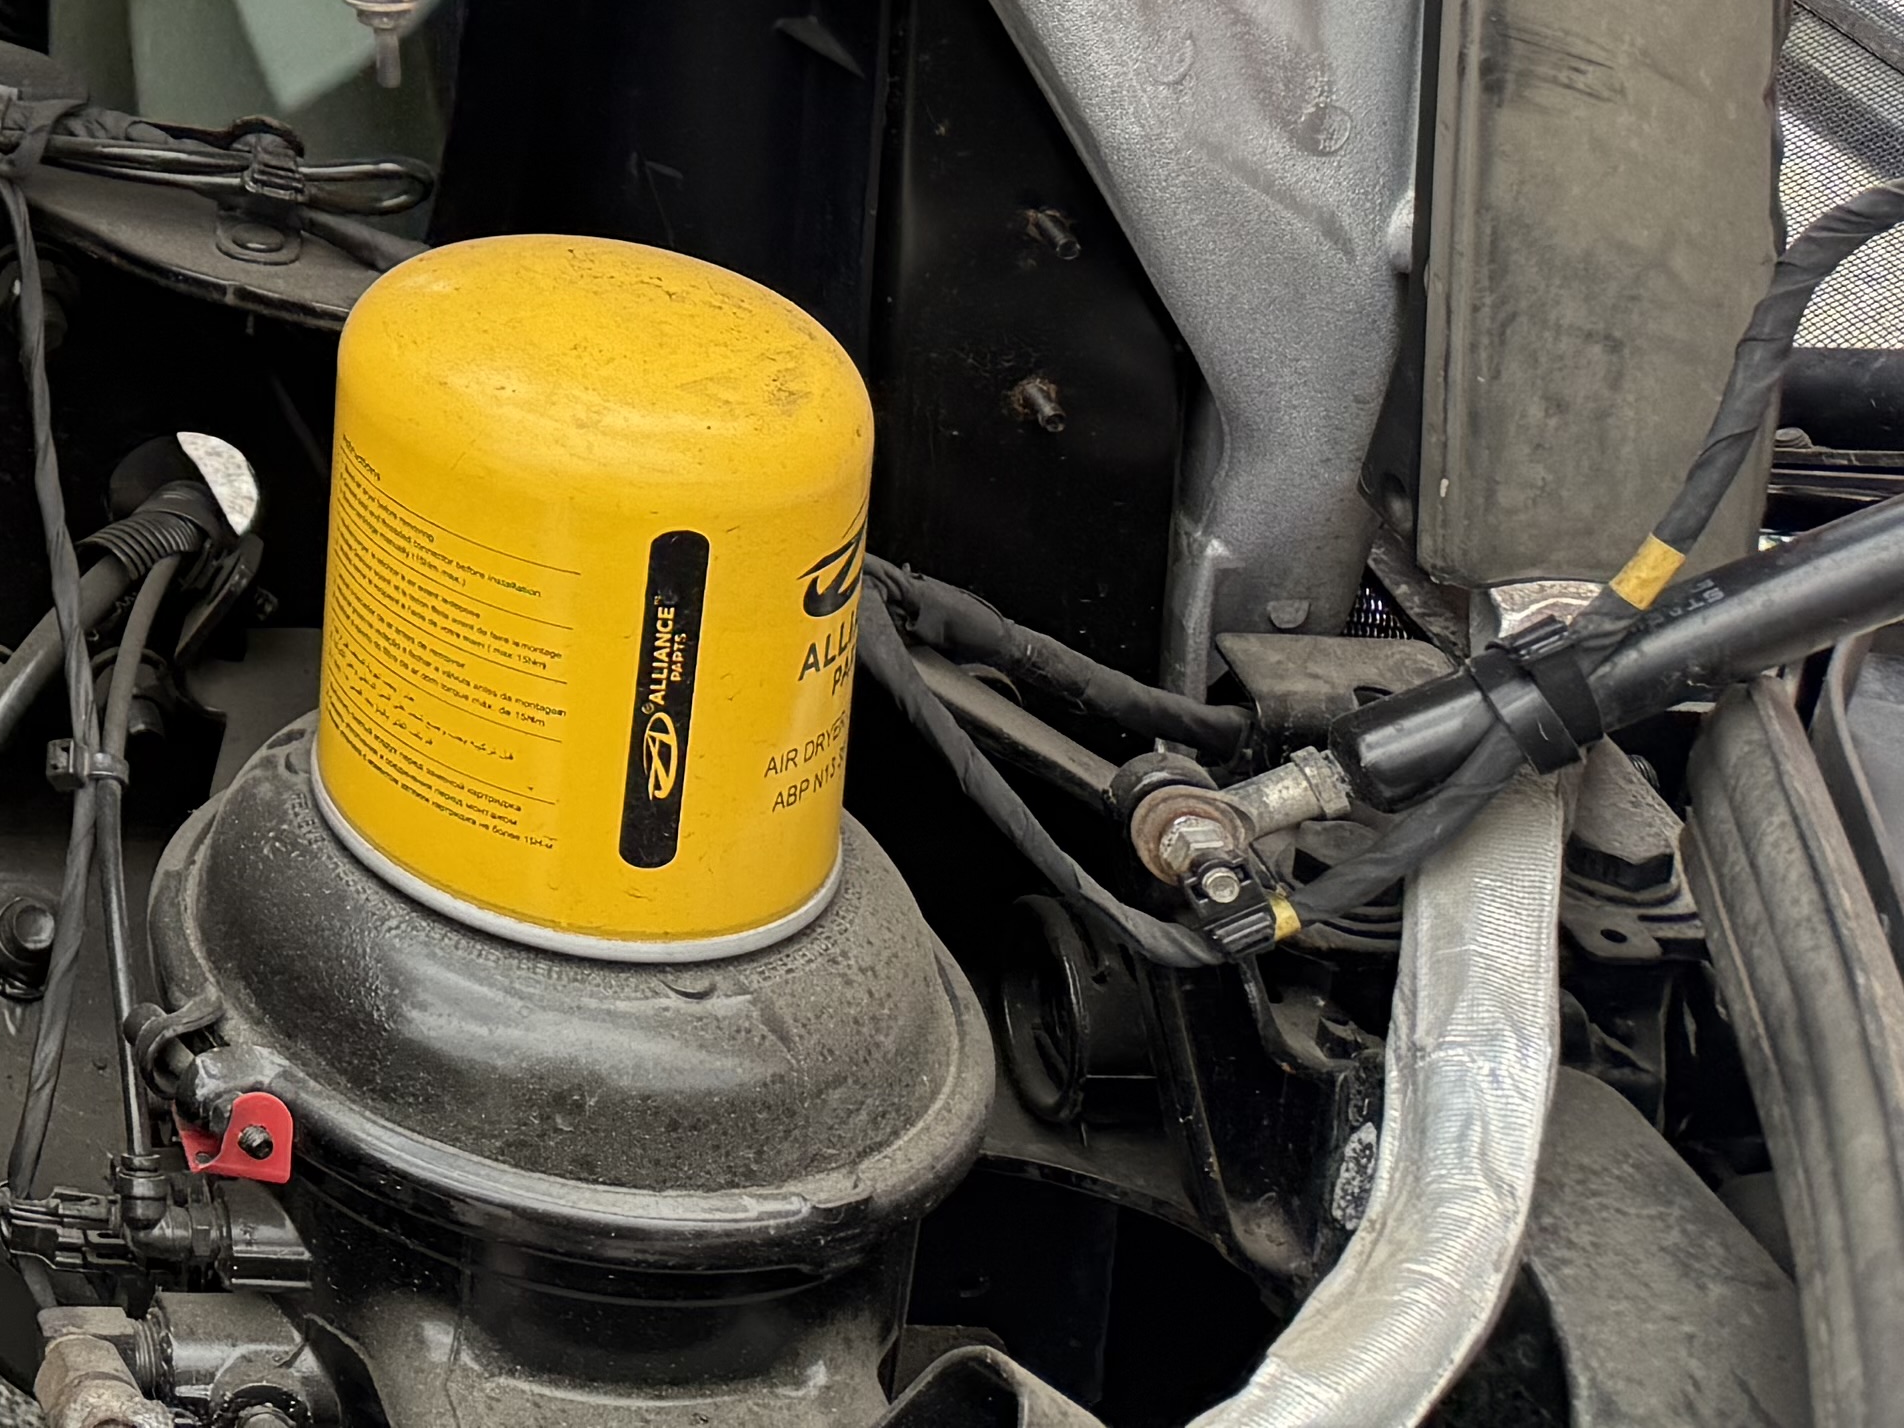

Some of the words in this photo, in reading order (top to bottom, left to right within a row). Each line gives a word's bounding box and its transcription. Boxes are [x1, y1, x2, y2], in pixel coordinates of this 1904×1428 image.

[648, 606, 675, 706] ALLIANCE
[670, 633, 688, 682] PARTS
[797, 610, 858, 682] ALLI
[764, 748, 799, 778] AIR
[772, 777, 810, 813] ABP
